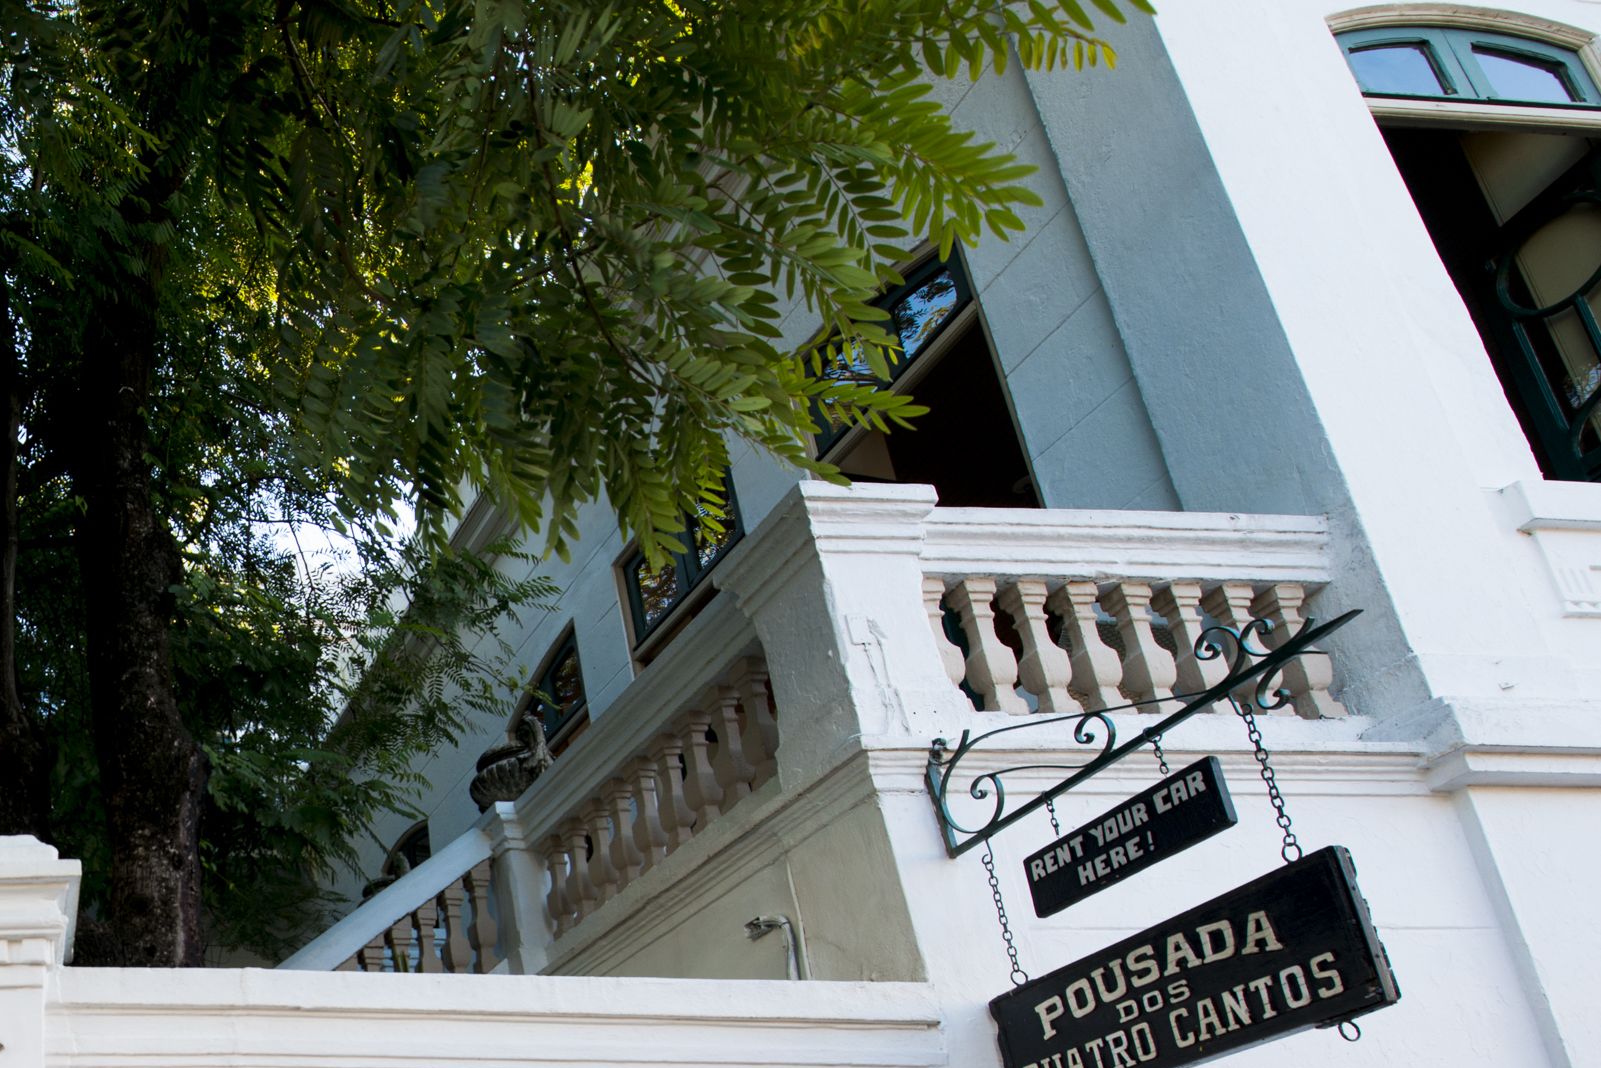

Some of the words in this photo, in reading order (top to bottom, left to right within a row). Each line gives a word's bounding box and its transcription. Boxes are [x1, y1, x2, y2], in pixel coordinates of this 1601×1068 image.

[1030, 834, 1084, 882] RENT
[1088, 802, 1150, 847] YOUR
[1152, 770, 1207, 815] CAR
[1034, 910, 1284, 1041] POUSADA
[1116, 978, 1192, 1024] DOS
[1169, 951, 1345, 1049] CANTOS
